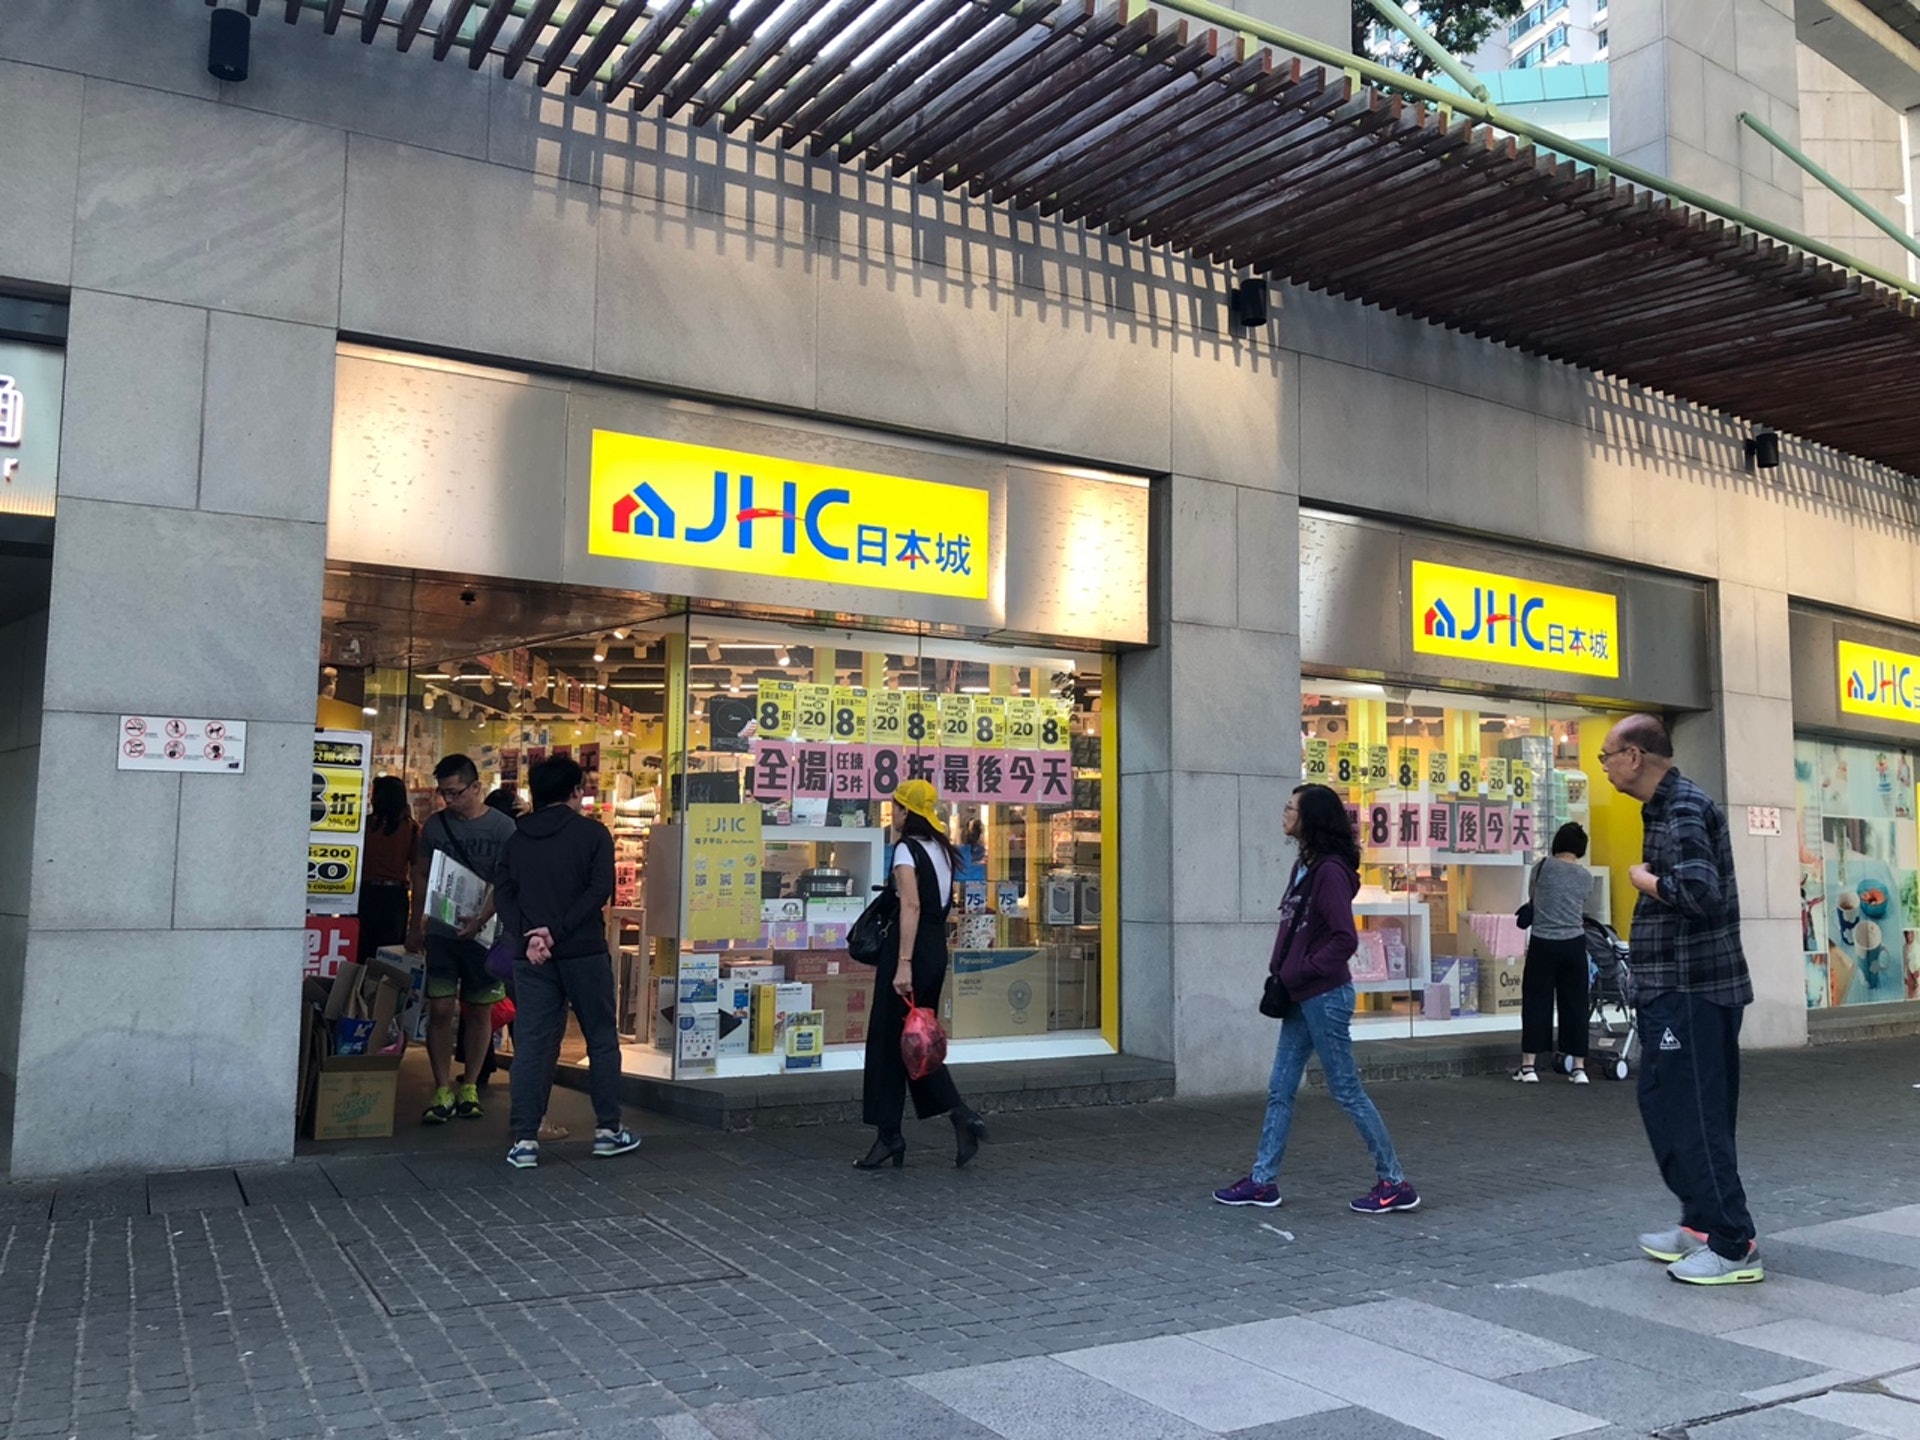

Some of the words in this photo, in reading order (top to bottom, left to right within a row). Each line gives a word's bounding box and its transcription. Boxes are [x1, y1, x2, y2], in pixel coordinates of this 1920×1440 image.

[685, 470, 850, 561] JHC
[857, 523, 972, 576] 日本城
[1460, 587, 1545, 652] JHC
[1549, 624, 1609, 660] 日本城
[1867, 659, 1912, 708] JHC
[313, 883, 346, 892] coupon
[959, 956, 994, 965] Panasonic
